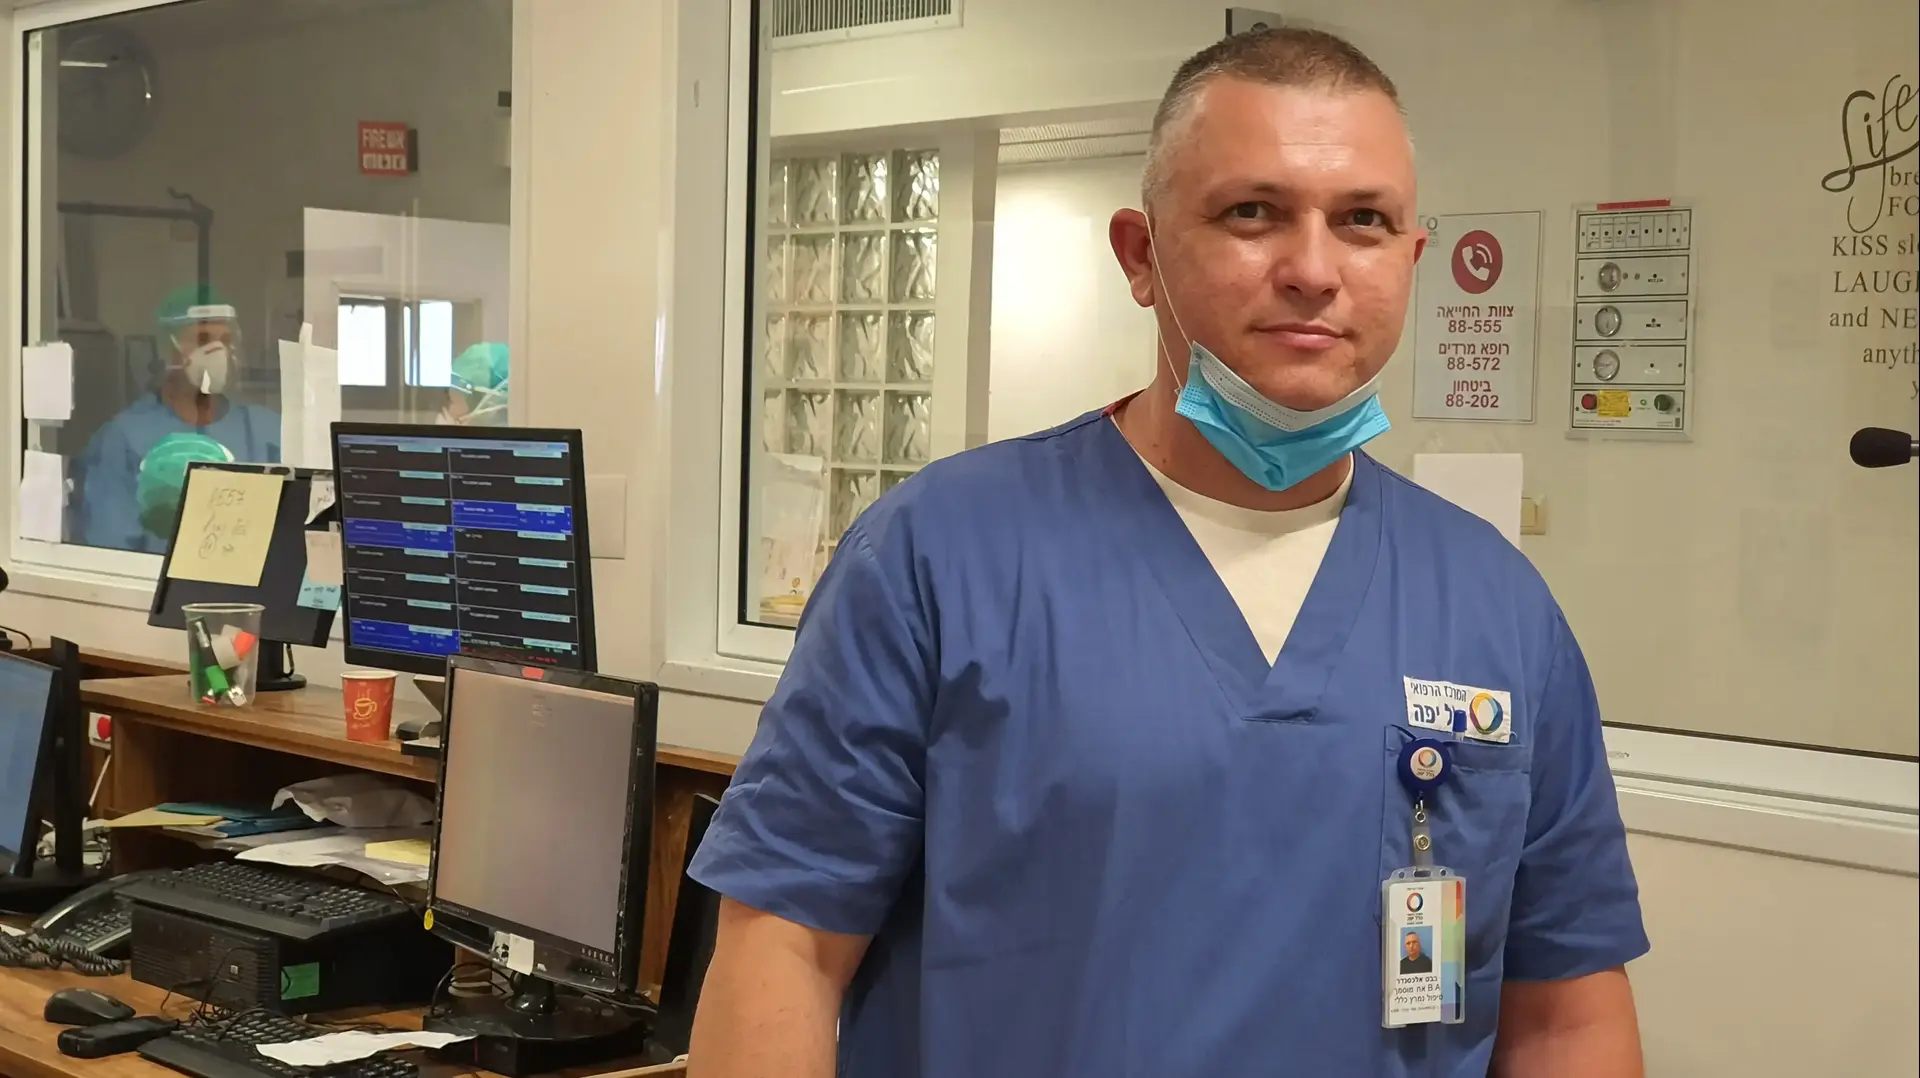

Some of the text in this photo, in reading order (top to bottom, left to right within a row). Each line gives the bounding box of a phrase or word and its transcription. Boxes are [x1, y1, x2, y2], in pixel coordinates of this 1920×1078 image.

[1821, 74, 1919, 233] Life
[1832, 234, 1889, 257] KISS
[1437, 306, 1514, 318] צוות החייאה
[1829, 305, 1918, 329] and NE
[1448, 320, 1502, 333] 88-555
[1438, 343, 1510, 355] רופא מרדים
[1447, 357, 1500, 371] 88-572
[1453, 380, 1491, 395] ביטחון
[1446, 394, 1499, 408] 88-202
[1410, 682, 1467, 702] המרכז הרפואי
[1413, 703, 1440, 724] יפה
